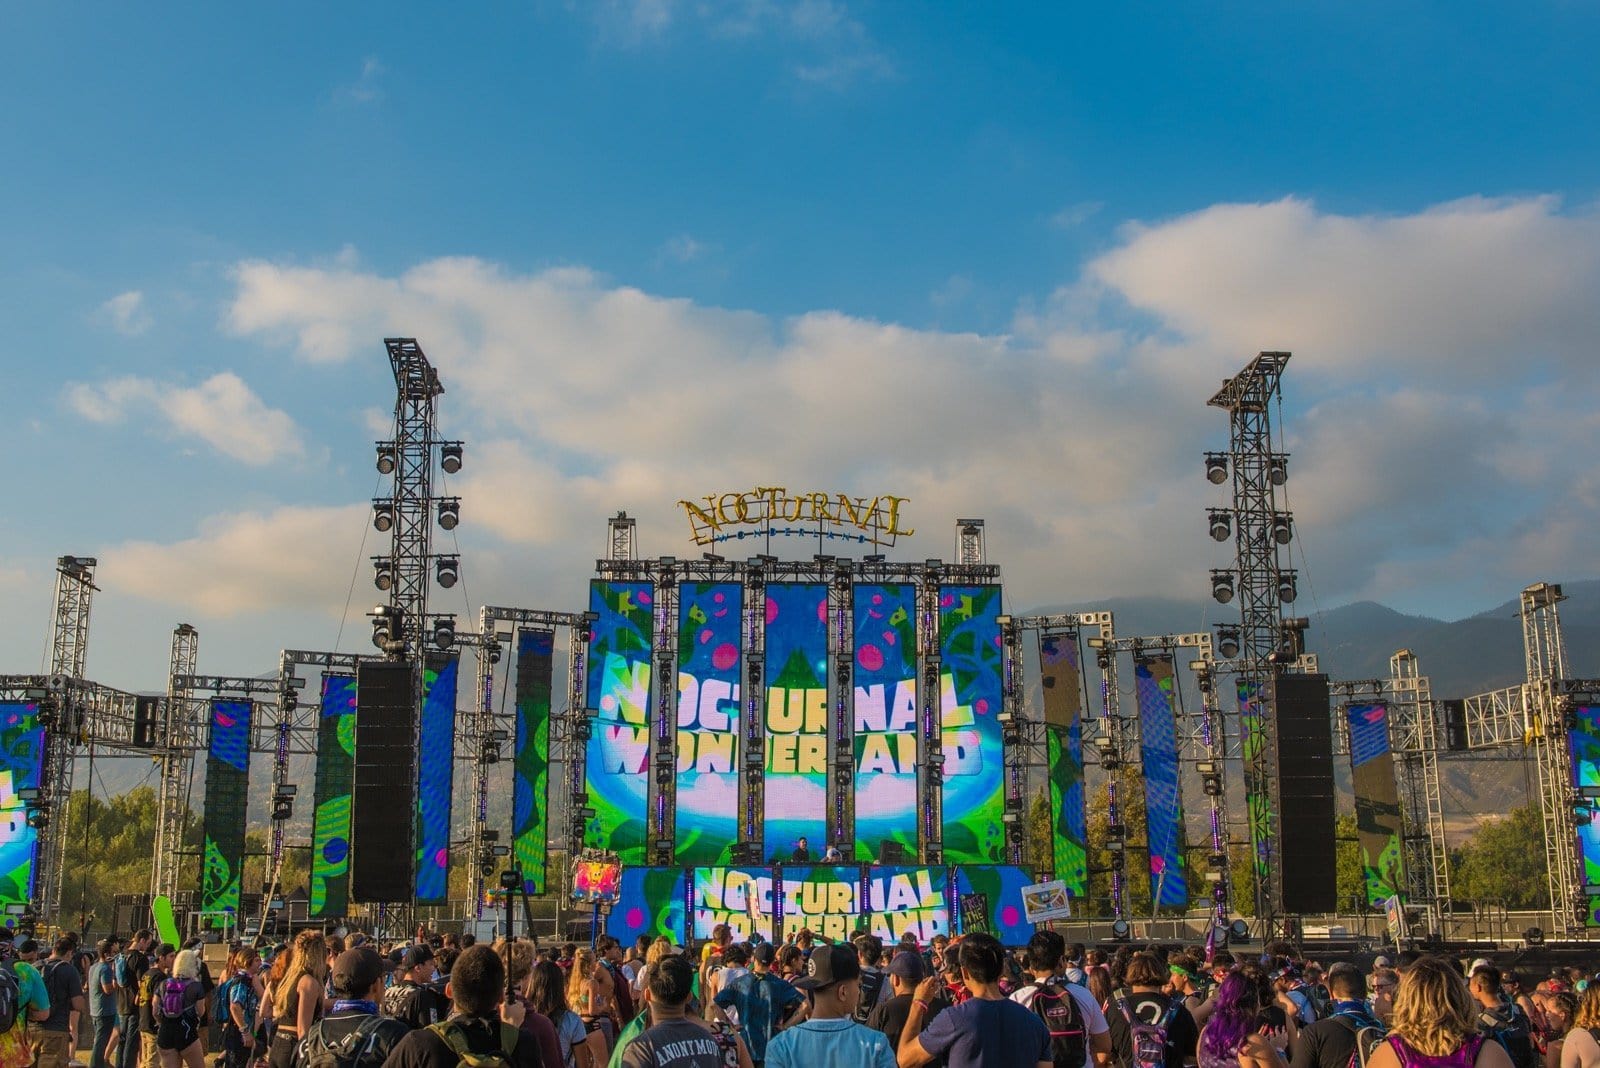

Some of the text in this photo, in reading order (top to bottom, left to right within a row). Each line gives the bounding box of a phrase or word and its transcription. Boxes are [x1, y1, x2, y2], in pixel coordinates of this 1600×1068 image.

[677, 487, 914, 543] NOCTURNAL
[716, 527, 866, 544] WONDERLAND
[600, 651, 975, 733] NCURNAL
